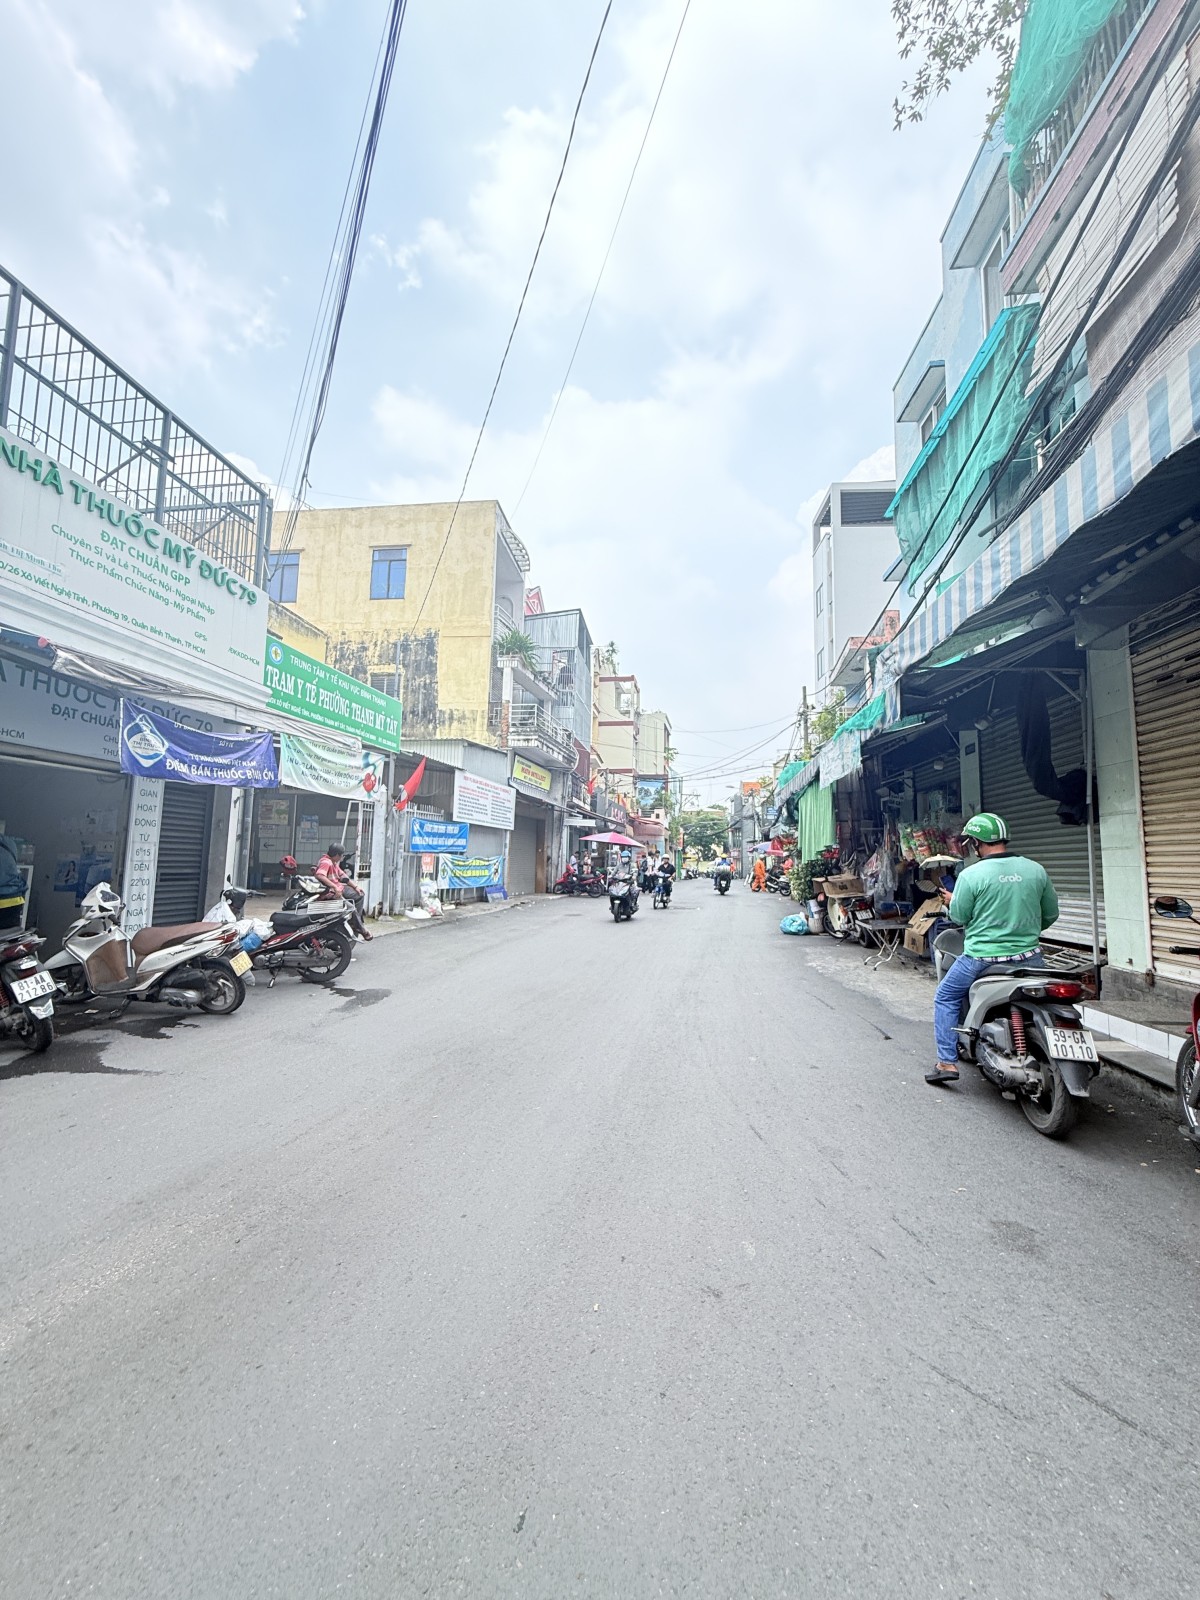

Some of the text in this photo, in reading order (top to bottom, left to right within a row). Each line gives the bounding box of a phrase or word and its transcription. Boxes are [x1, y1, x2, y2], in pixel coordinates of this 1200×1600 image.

[70, 479, 160, 550] THUỐC
[163, 537, 197, 568] MỸ
[100, 529, 191, 586] ĐẠT CHUẨN GPP
[51, 524, 92, 552] Chuyên
[105, 552, 116, 564] và
[131, 565, 157, 586] Thuốc
[197, 599, 216, 616] Nhập
[69, 547, 94, 566] Thực
[125, 577, 147, 594] Chức
[20, 569, 33, 581] Xô
[33, 575, 50, 589] Viết
[51, 582, 72, 599] Nghệ
[91, 600, 120, 620] Phường
[131, 617, 149, 631] Quận
[290, 655, 312, 673] TRUNG
[313, 666, 325, 679] TÂM
[325, 673, 330, 681] Y
[330, 672, 338, 684] TẾ
[338, 679, 350, 690] KHU
[266, 664, 398, 736] TRẠM Y TẾ PHƯỜNG THẠNH MỸ TÂY
[51, 703, 78, 721] ĐẠT
[190, 763, 211, 777] BÁN
[213, 766, 246, 779] THUỐC
[139, 788, 158, 799] GIAN
[967, 823, 981, 833] Grab
[133, 861, 150, 872] ĐẾN
[998, 873, 1023, 883] Grab
[131, 890, 147, 901] CÁC
[17, 974, 47, 991] 81-AA
[1052, 1029, 1087, 1045] 59-GA
[1053, 1043, 1094, 1060] 101.10
